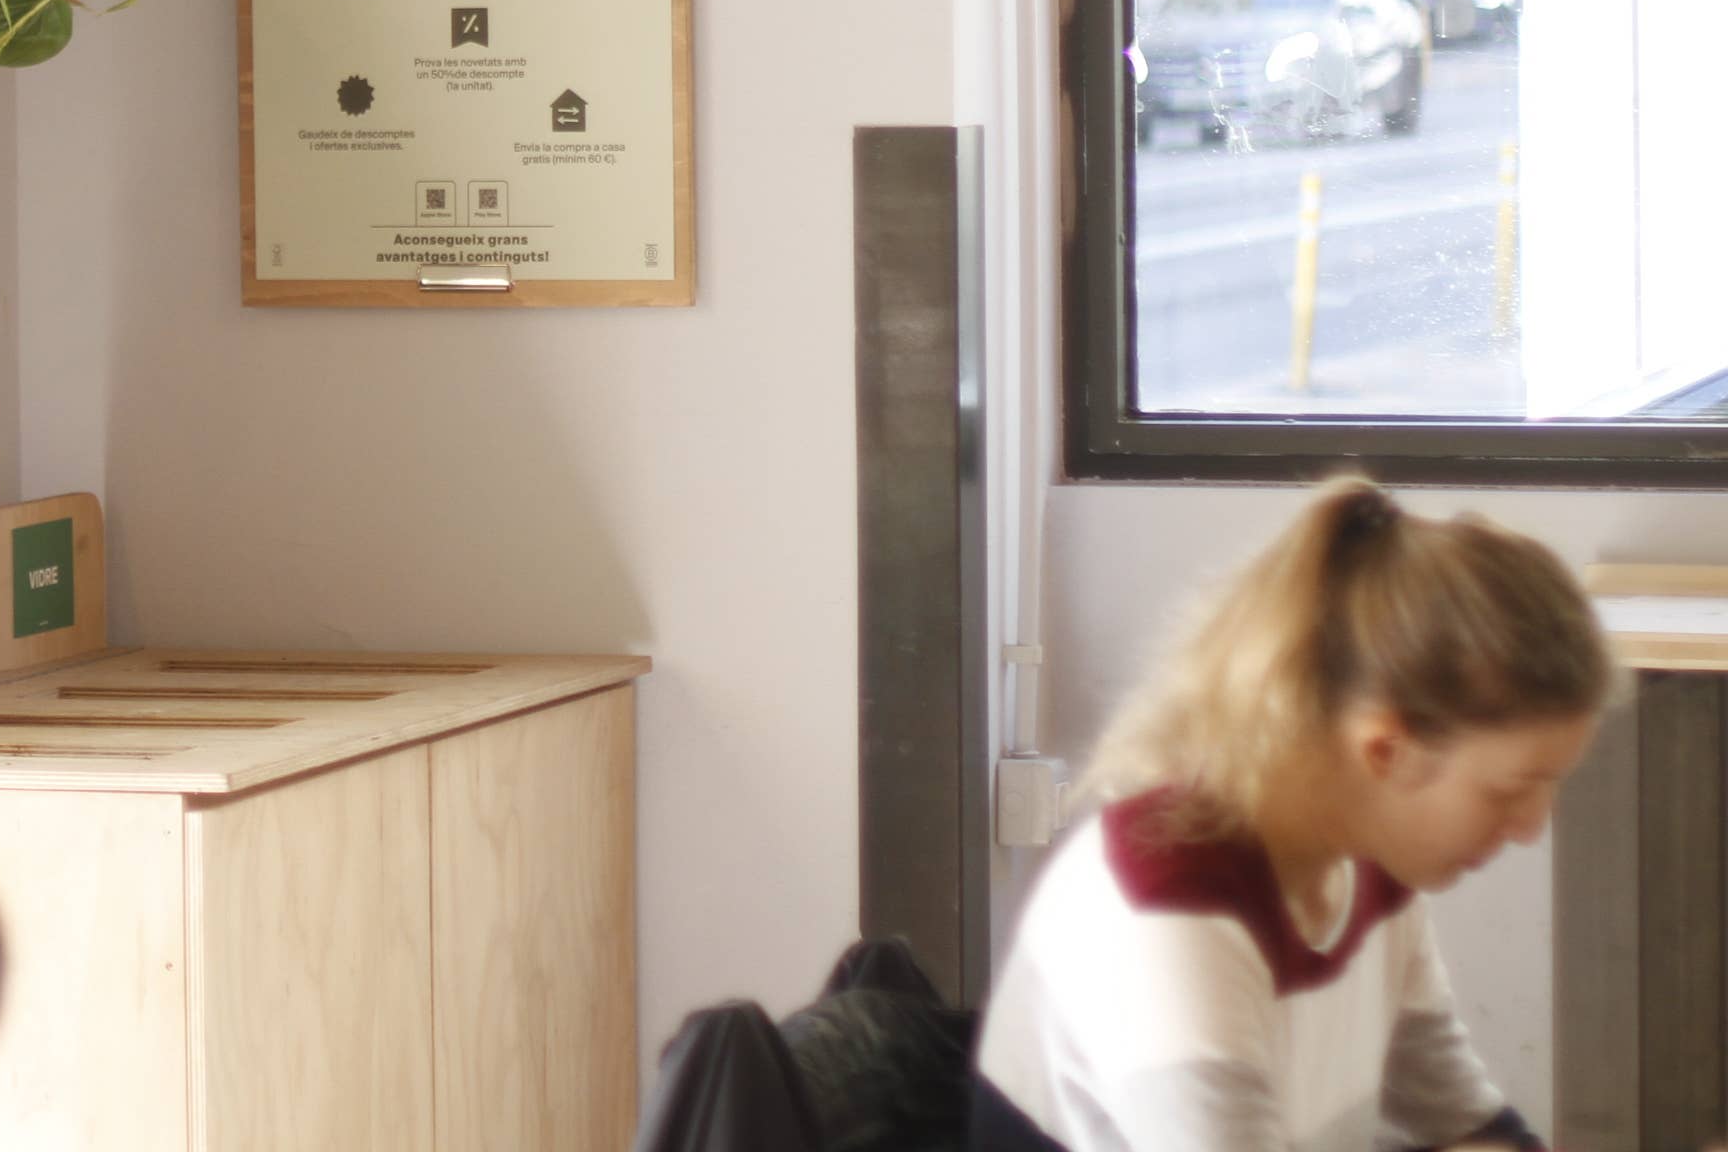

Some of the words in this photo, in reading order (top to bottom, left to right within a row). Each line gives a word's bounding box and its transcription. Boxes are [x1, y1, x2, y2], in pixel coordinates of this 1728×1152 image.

[414, 58, 442, 67] Prova
[393, 233, 484, 247] Aconsegueix
[487, 235, 528, 247] grans
[376, 250, 456, 264] avantatges
[466, 250, 549, 264] continguts!
[28, 565, 59, 589] VIDRE
